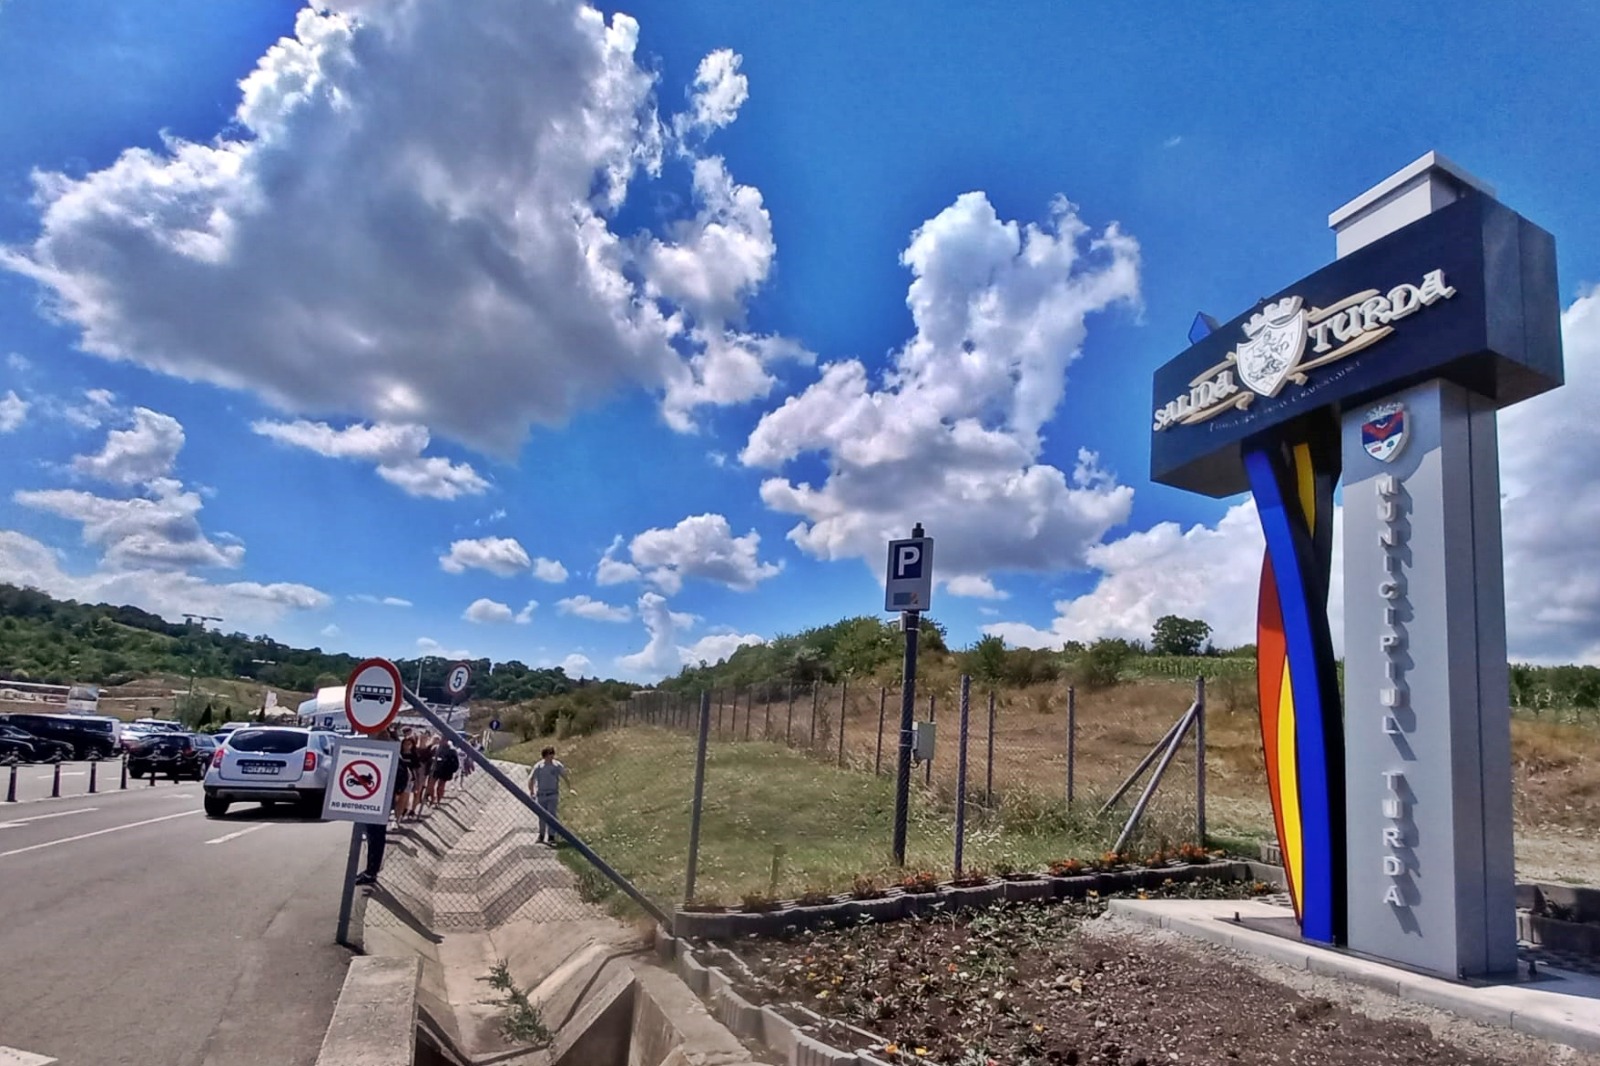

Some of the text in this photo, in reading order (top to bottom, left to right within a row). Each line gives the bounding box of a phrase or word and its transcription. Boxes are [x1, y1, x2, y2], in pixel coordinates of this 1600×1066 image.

[1153, 370, 1239, 431] SALINA
[1307, 268, 1457, 353] TURDA
[898, 546, 920, 576] P
[453, 671, 465, 689] 5
[1376, 475, 1404, 906] MUNICIPIUL TURDA
[341, 802, 381, 812] MOTORCYCLE
